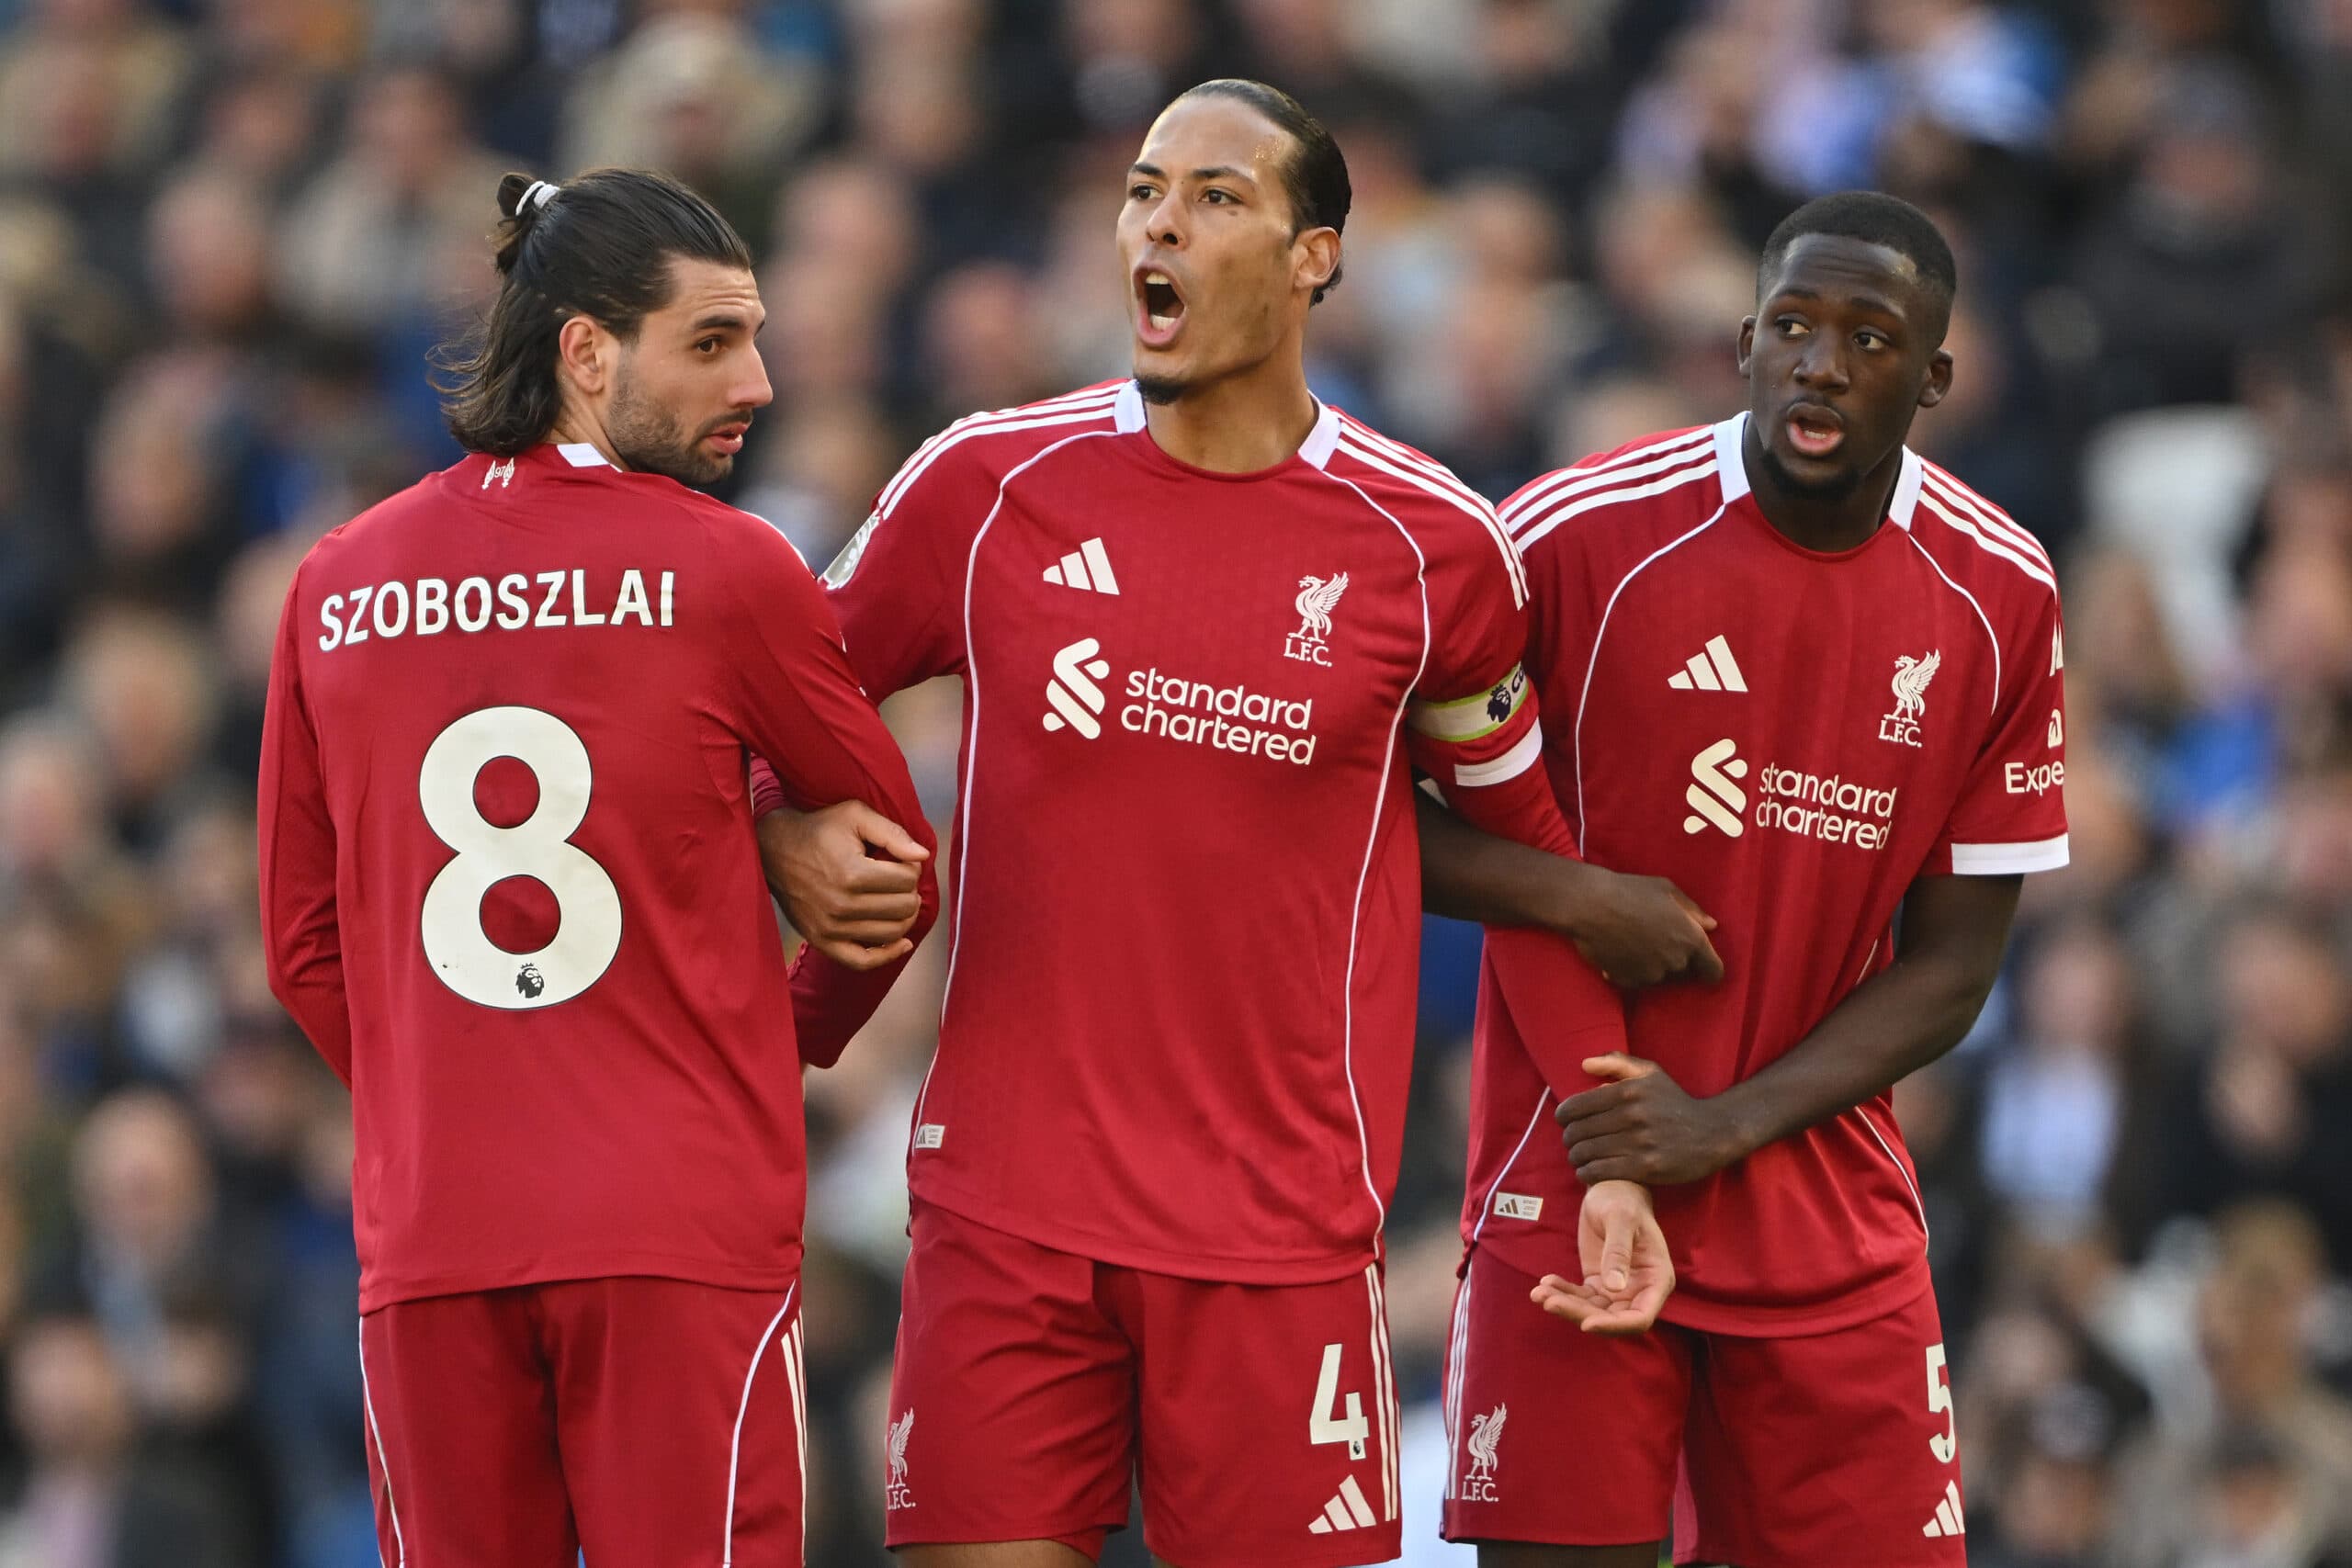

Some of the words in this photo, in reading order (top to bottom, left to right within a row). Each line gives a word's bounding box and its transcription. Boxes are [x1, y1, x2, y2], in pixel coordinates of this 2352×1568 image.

[318, 568, 675, 651] SZOBOSZLAI
[1283, 637, 1332, 667] L.F.C.
[1125, 667, 1313, 730] standard
[1120, 701, 1317, 766] chartered
[1878, 719, 1923, 748] L.F.C.
[1758, 761, 1898, 818] standard
[1756, 795, 1893, 852] chartered
[418, 705, 623, 1010] 8
[1309, 1343, 1370, 1461] 4
[1925, 1342, 1957, 1464] 5
[1461, 1481, 1499, 1503] L.F.C.
